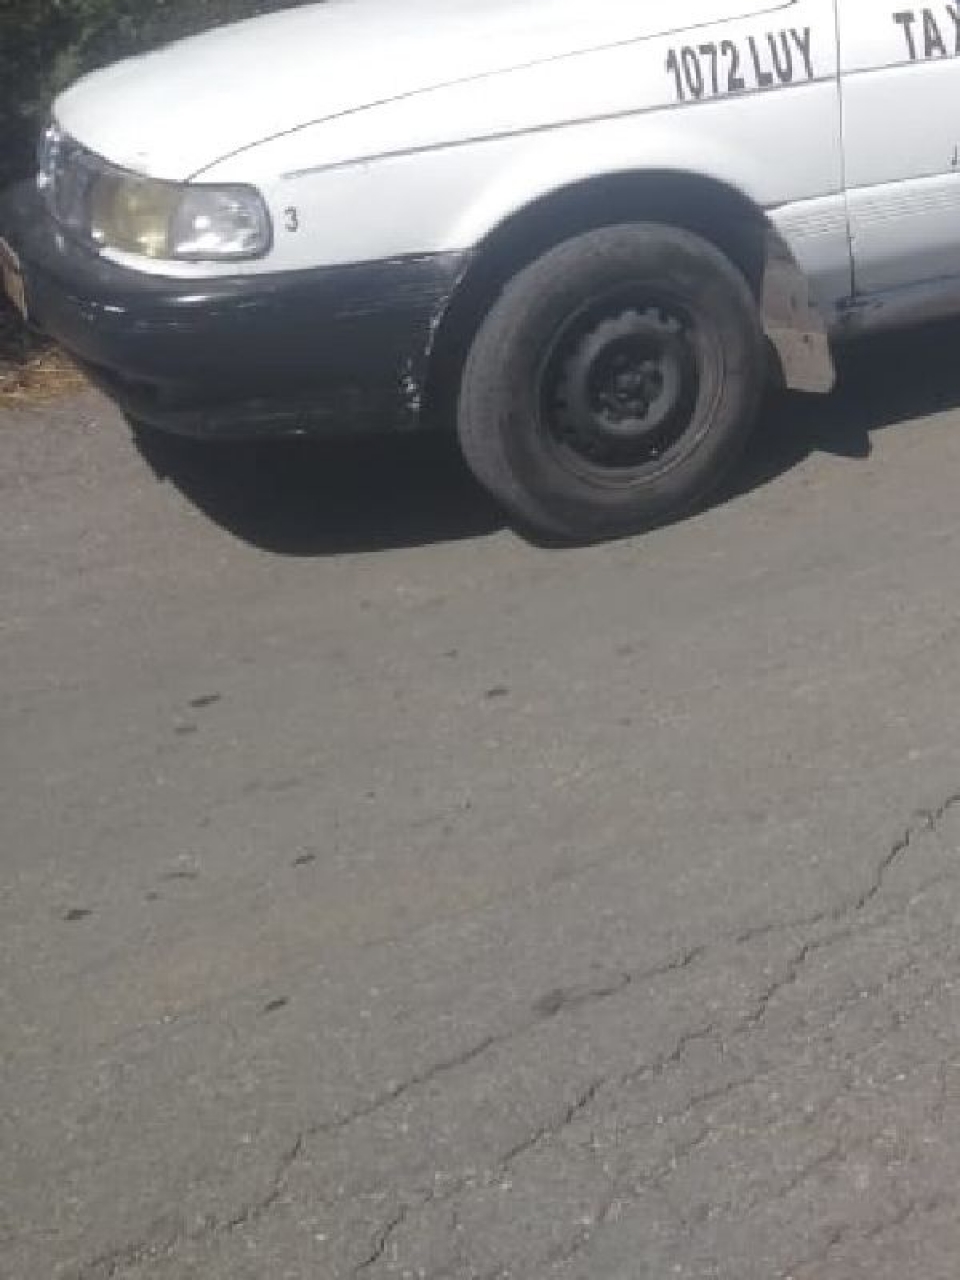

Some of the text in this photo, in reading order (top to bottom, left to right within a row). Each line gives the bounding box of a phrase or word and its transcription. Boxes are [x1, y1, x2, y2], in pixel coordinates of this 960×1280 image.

[664, 27, 813, 101] 1072 LUY
[284, 206, 298, 232] 3
